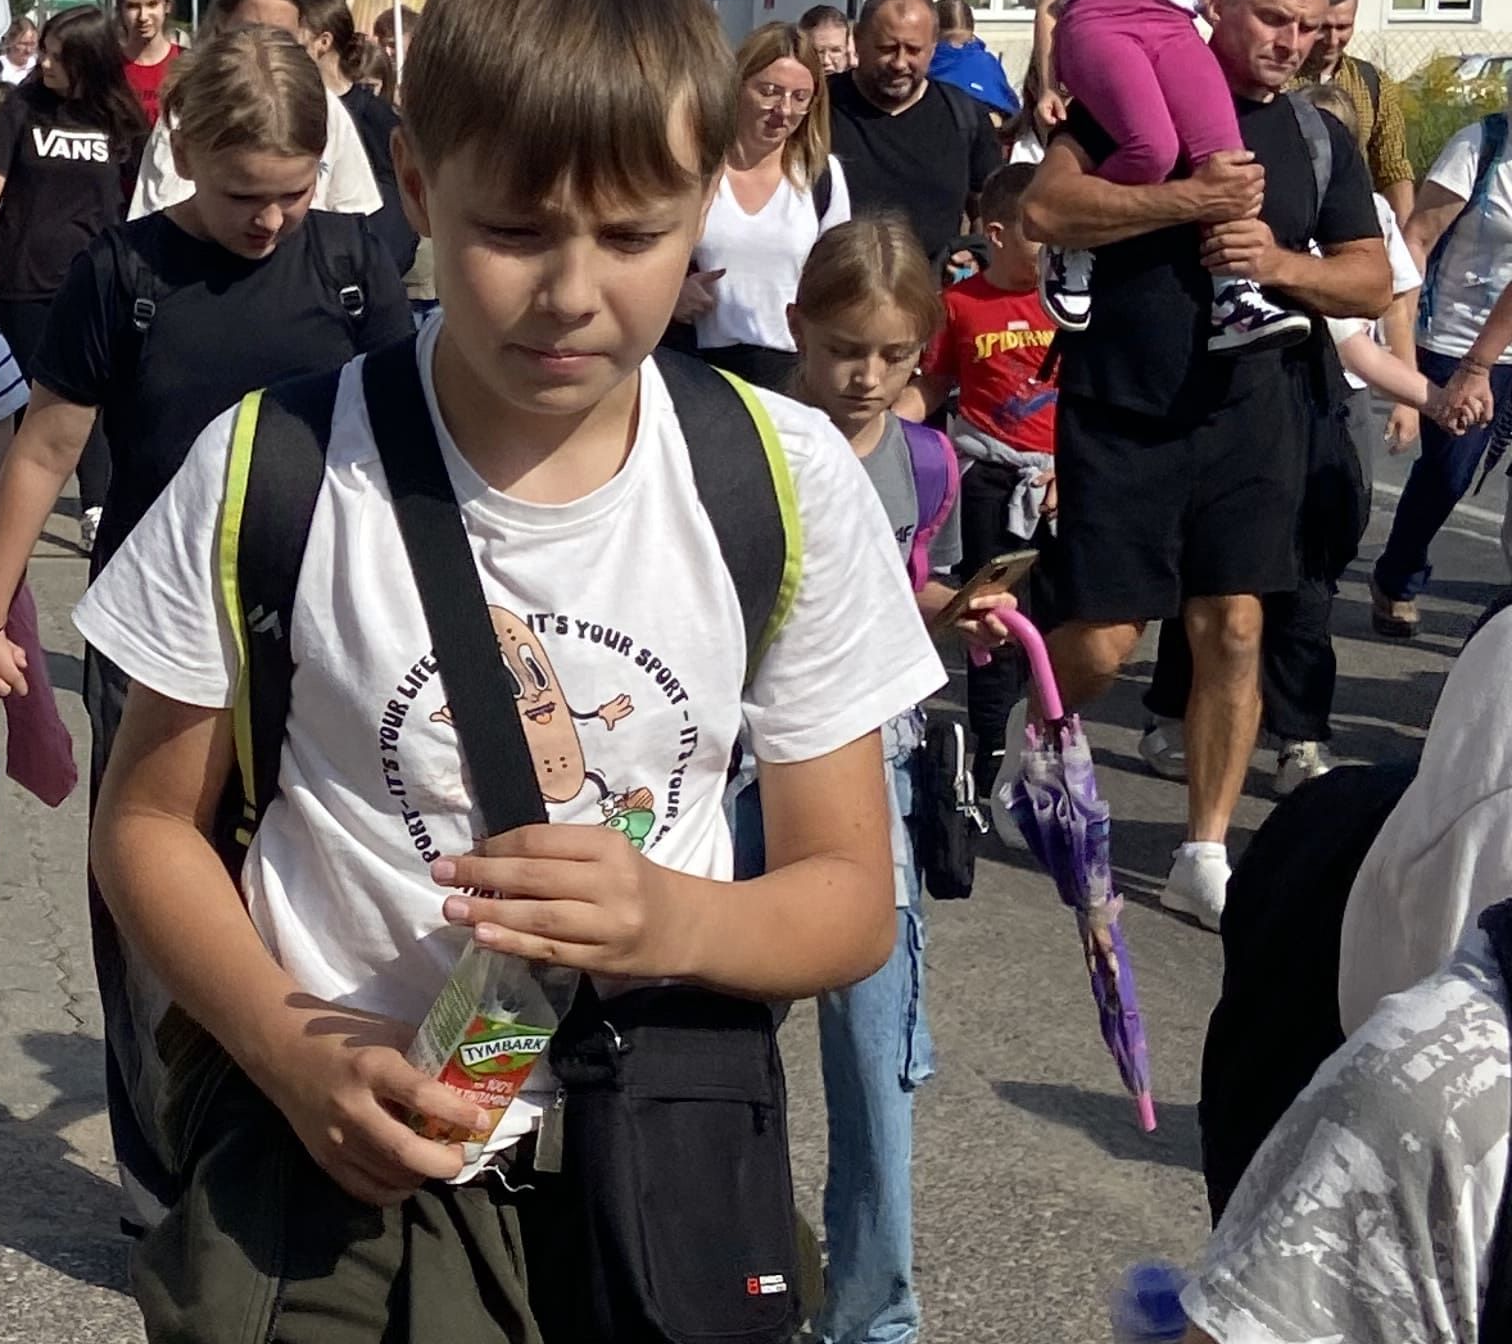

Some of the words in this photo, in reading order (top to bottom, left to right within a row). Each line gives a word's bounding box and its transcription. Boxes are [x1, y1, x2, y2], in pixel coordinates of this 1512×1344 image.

[32, 127, 109, 162] VANS
[380, 699, 409, 752] YOUR
[527, 612, 568, 635] IT'S
[575, 619, 633, 656] YOUR
[635, 648, 689, 705] SPORT
[665, 763, 688, 819] YOUR
[464, 1038, 545, 1062] TYMBARK
